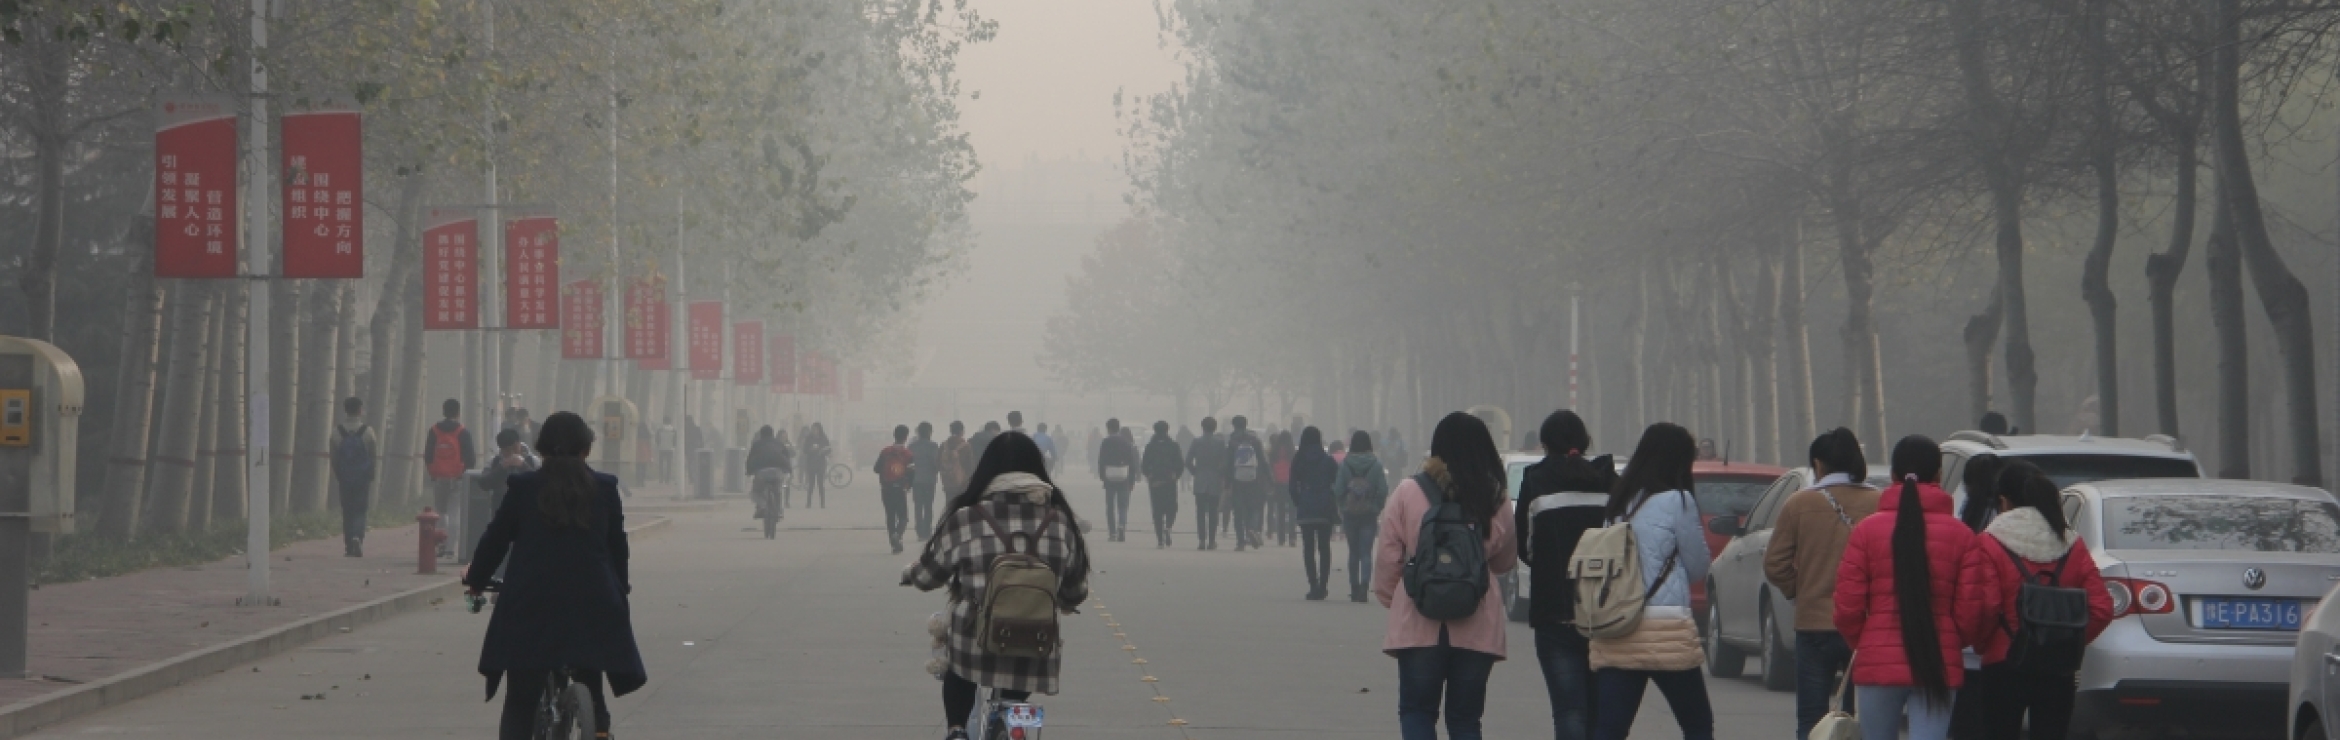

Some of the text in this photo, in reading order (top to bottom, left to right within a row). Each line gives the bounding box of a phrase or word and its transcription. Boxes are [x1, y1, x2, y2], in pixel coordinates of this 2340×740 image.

[161, 154, 177, 219] 引领发展
[184, 172, 200, 237] 凝聚人心
[313, 172, 330, 237] 围绕中心
[206, 190, 223, 254] 营造环境
[336, 190, 352, 254] 把握方向
